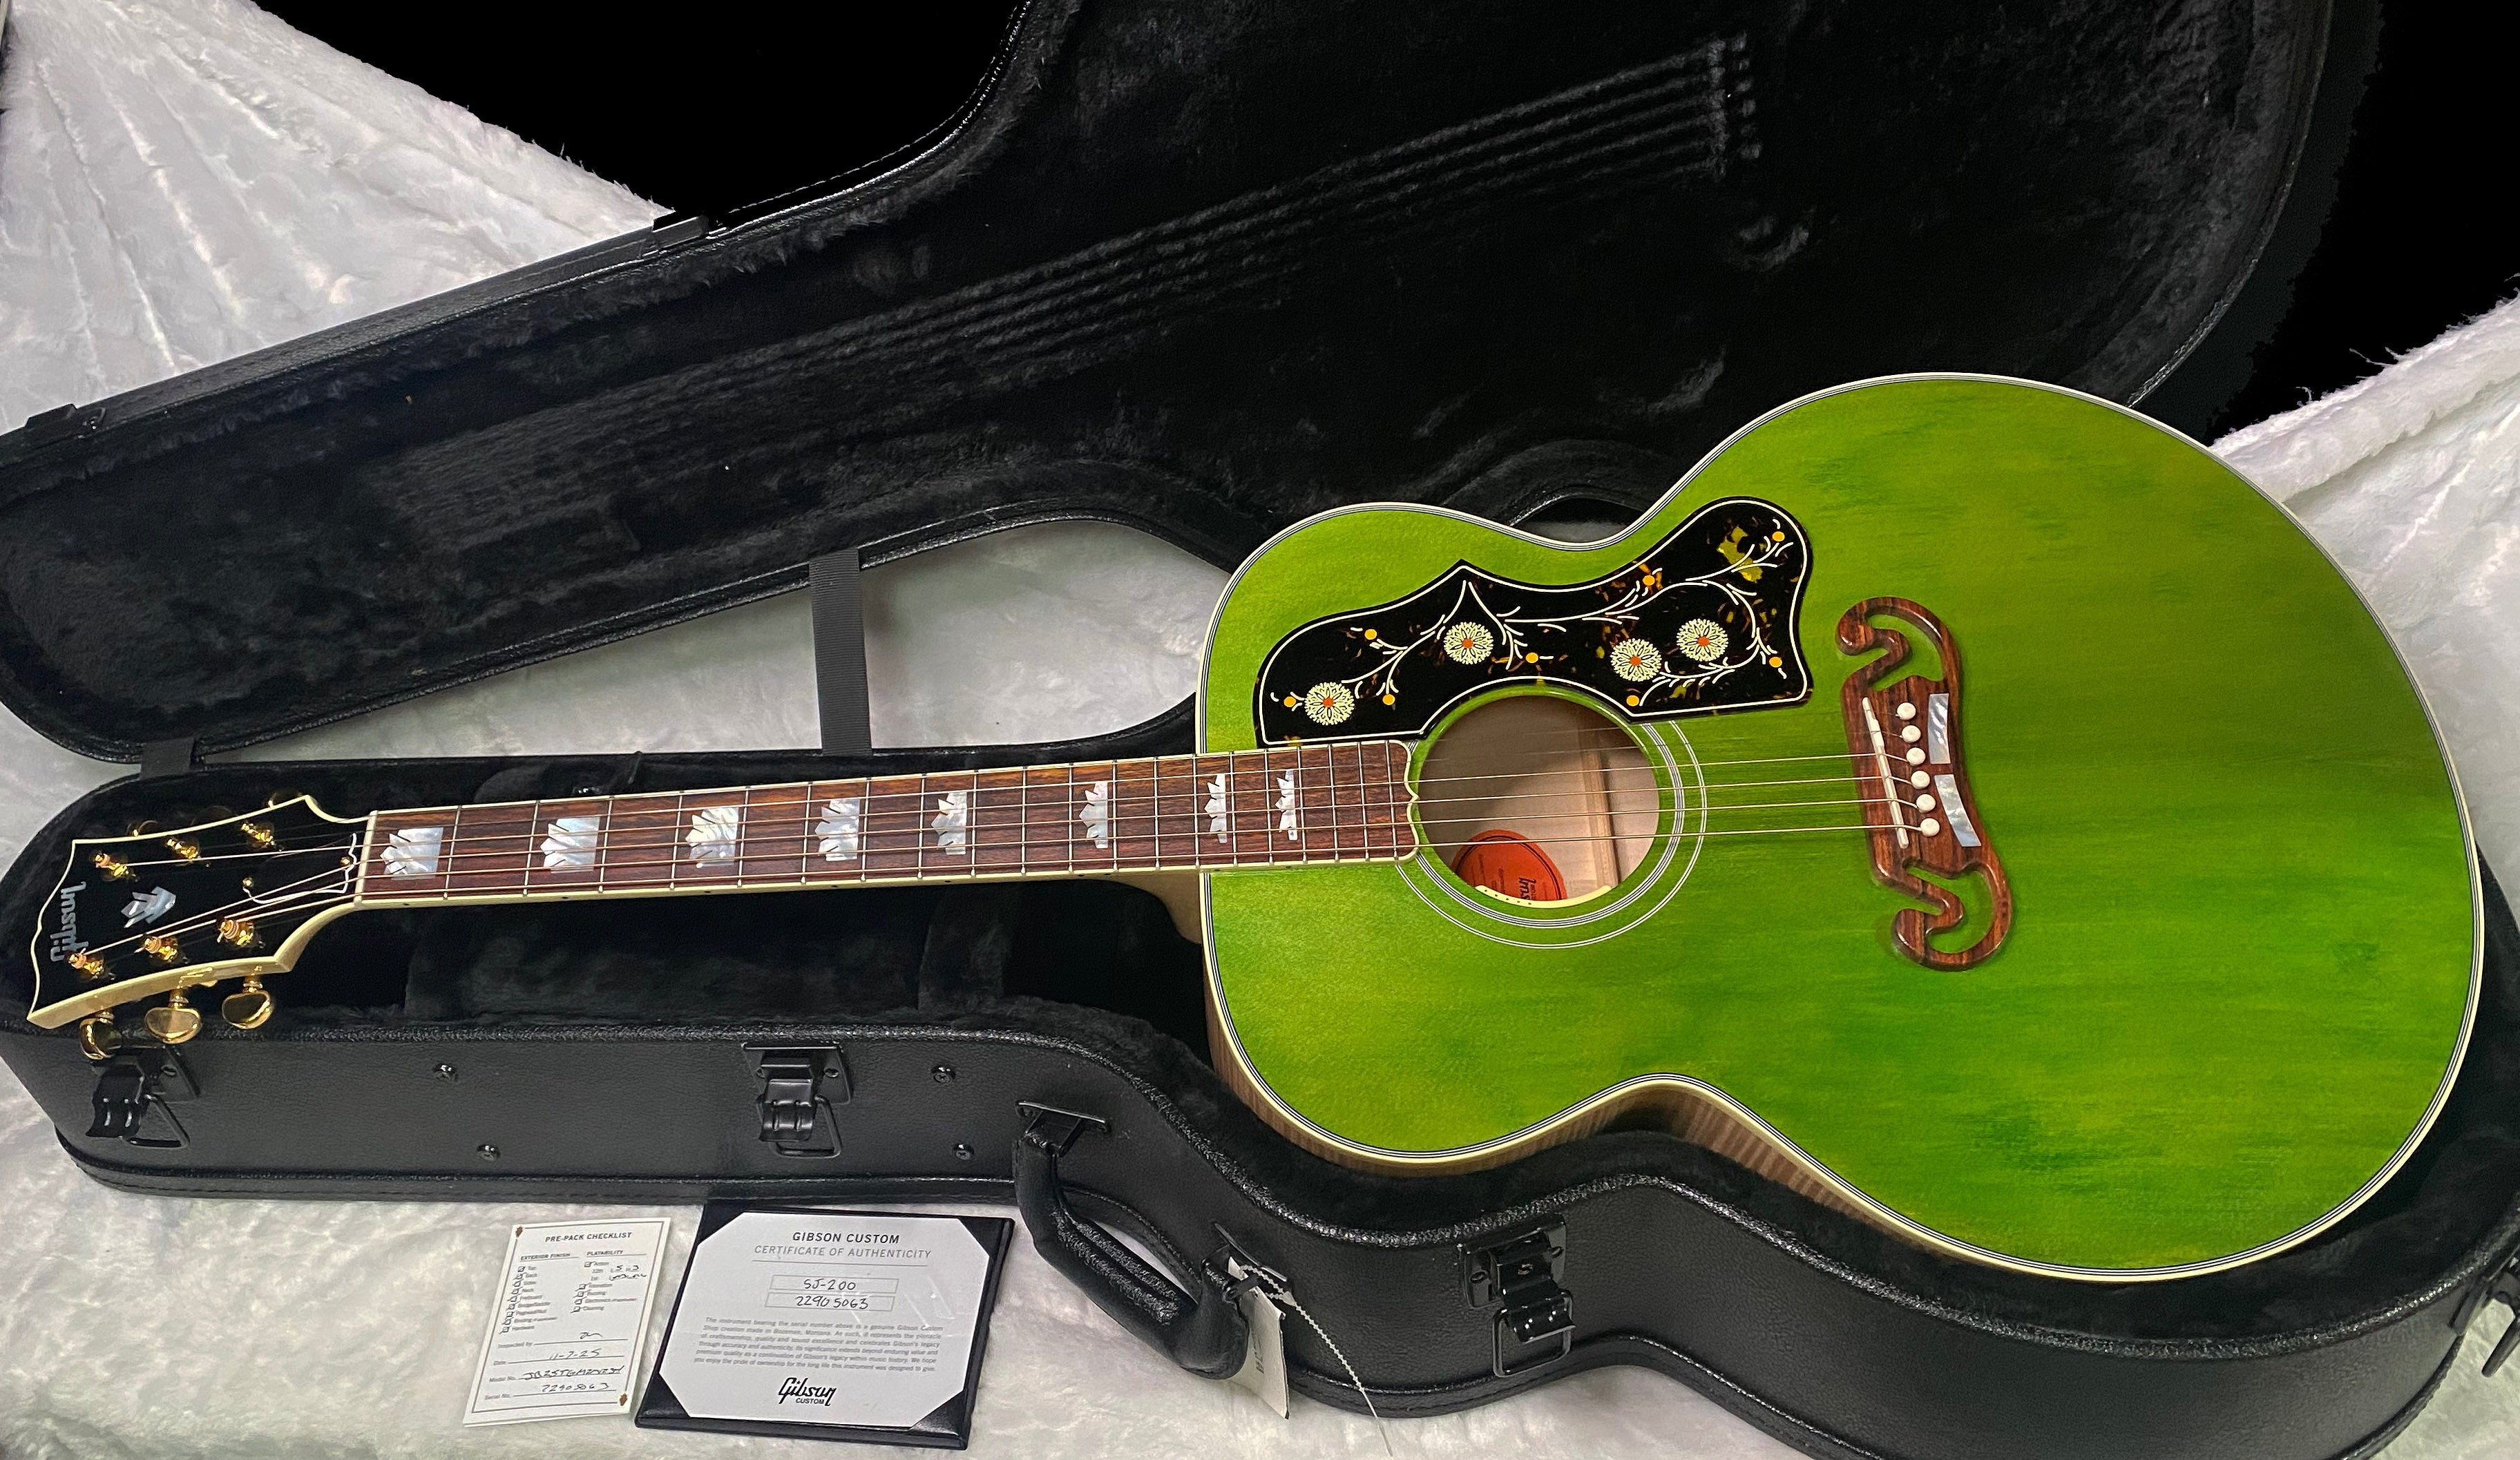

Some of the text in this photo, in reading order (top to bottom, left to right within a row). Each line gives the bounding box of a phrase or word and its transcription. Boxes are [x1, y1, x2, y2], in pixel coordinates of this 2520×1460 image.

[50, 881, 89, 962] Gibson
[544, 1232, 632, 1242] PRE-PACK CHECKLIST
[792, 1231, 900, 1244] GIBSON CUSTOM
[754, 1245, 932, 1259] CERTIFICATE OF AUTHENTICITY
[803, 1278, 857, 1291] SJ-200
[778, 1377, 837, 1406] Gibson
